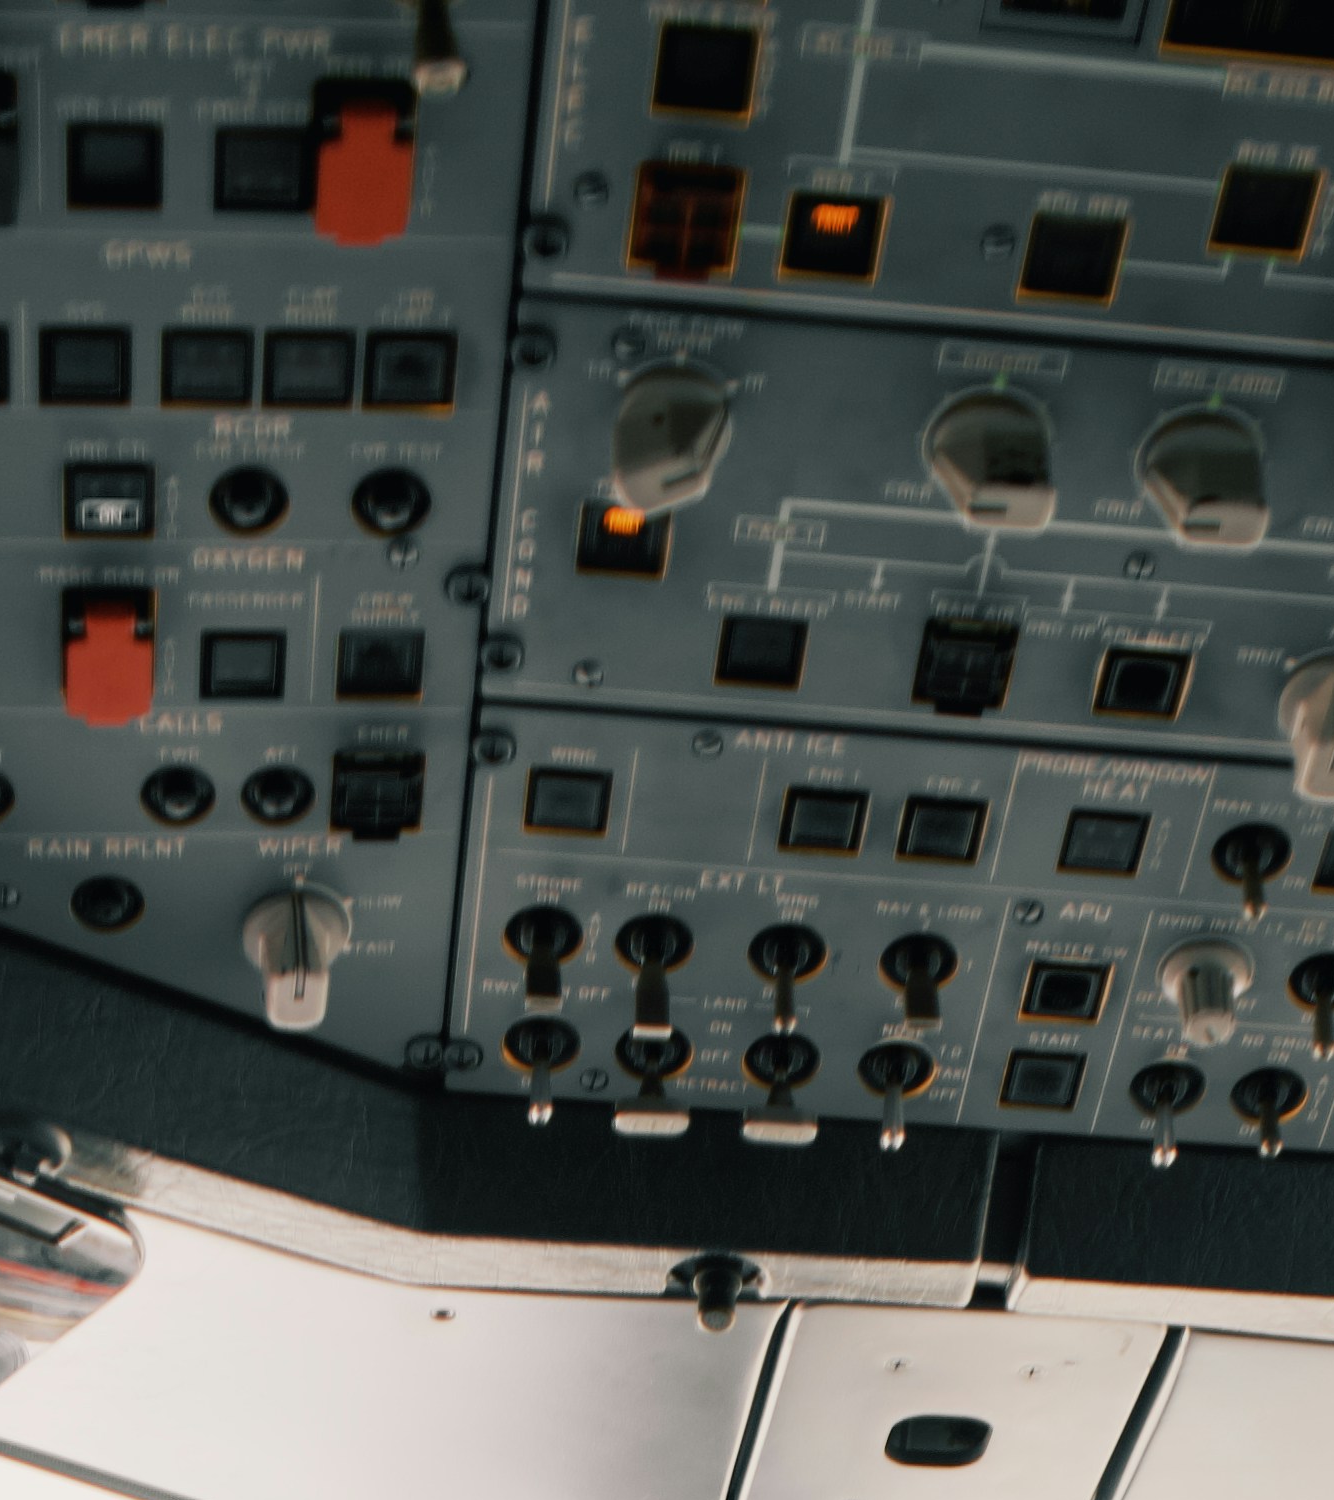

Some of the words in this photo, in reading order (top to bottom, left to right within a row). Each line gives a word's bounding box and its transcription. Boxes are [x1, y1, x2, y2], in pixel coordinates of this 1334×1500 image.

[264, 29, 331, 54] PWR
[103, 241, 192, 269] GPWS
[214, 415, 292, 439] RCDR
[193, 548, 305, 571] OXYGEN
[733, 730, 795, 754] ANTI
[805, 735, 847, 757] ICE
[1082, 777, 1151, 801] HEAT
[28, 837, 91, 858] RAIN
[258, 837, 342, 856] WIPER
[1059, 903, 1112, 923] APU
[1028, 1032, 1082, 1047] START
